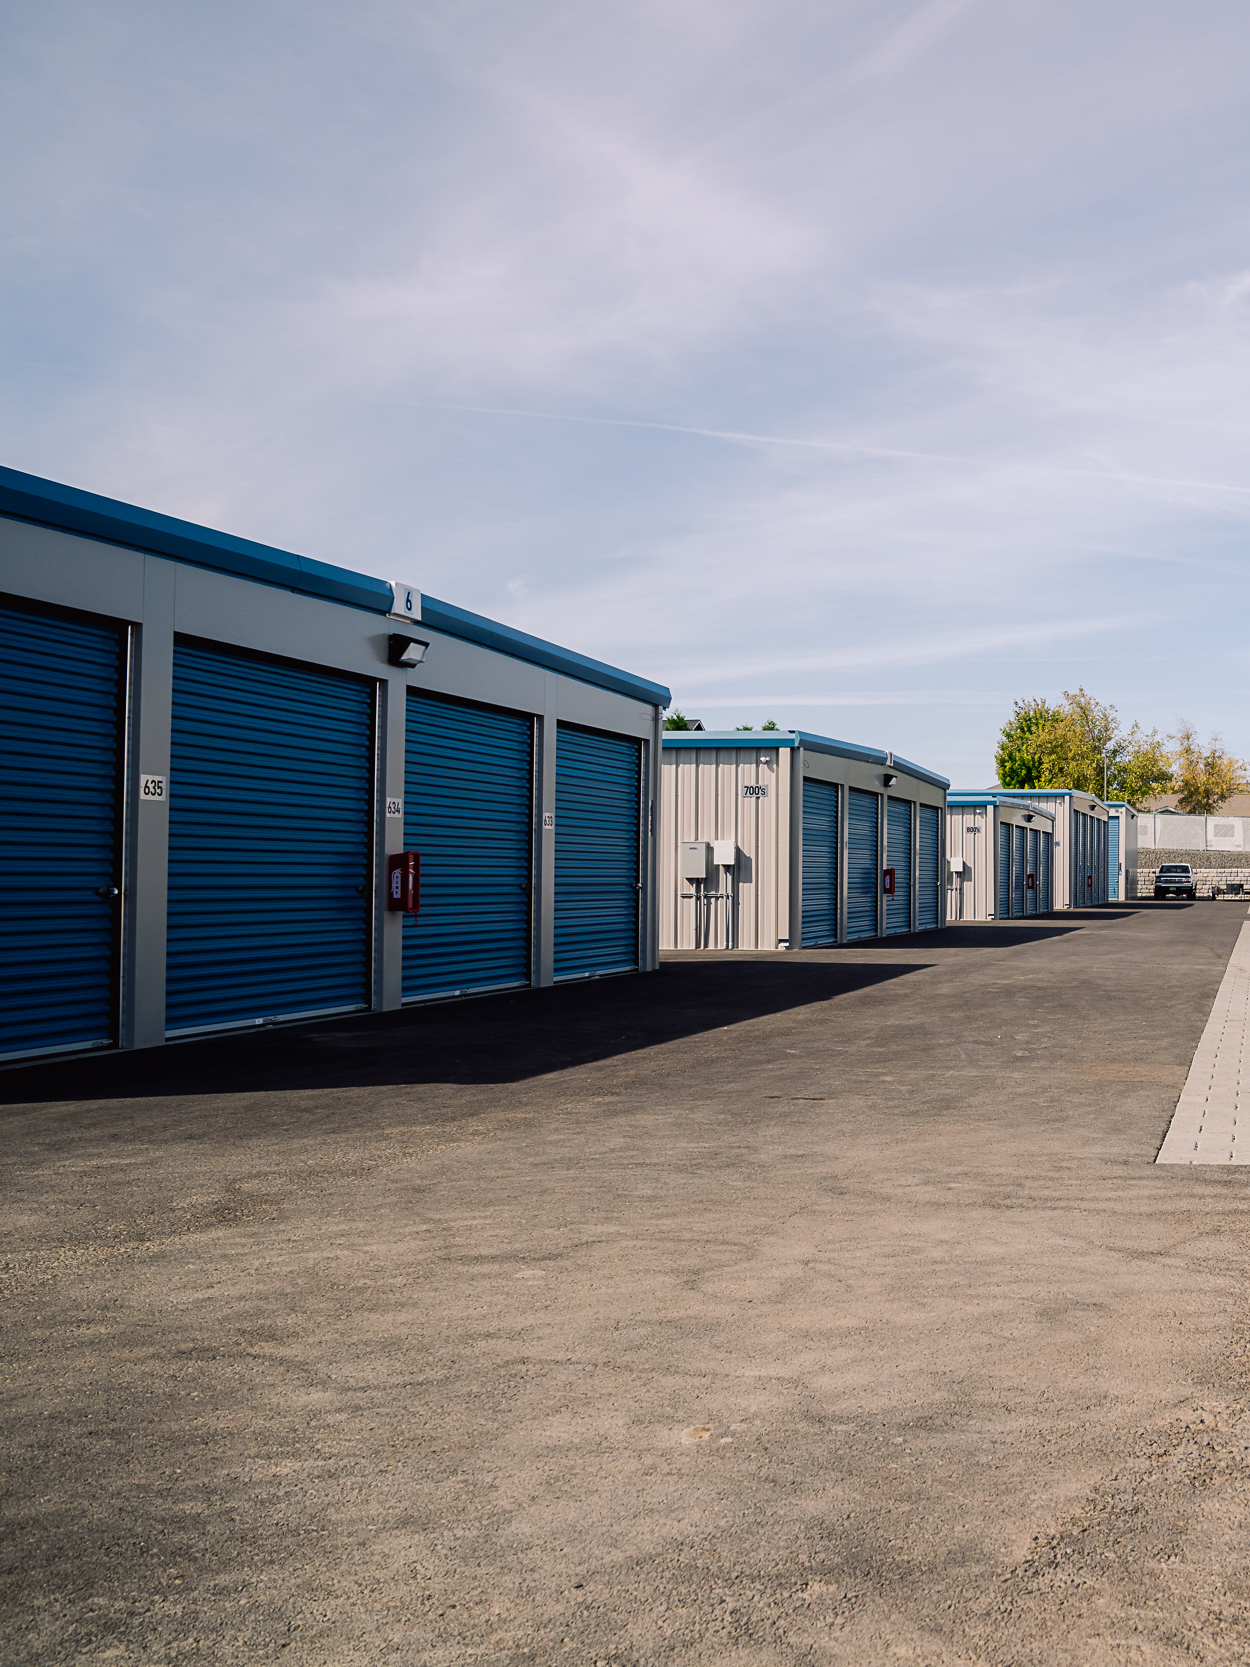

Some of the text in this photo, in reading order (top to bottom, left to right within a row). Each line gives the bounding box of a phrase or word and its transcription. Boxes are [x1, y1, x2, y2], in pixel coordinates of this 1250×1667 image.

[405, 591, 412, 612] 6
[144, 779, 163, 797] 635
[744, 786, 766, 796] 700's
[387, 801, 401, 815] 634
[543, 815, 553, 827] 633
